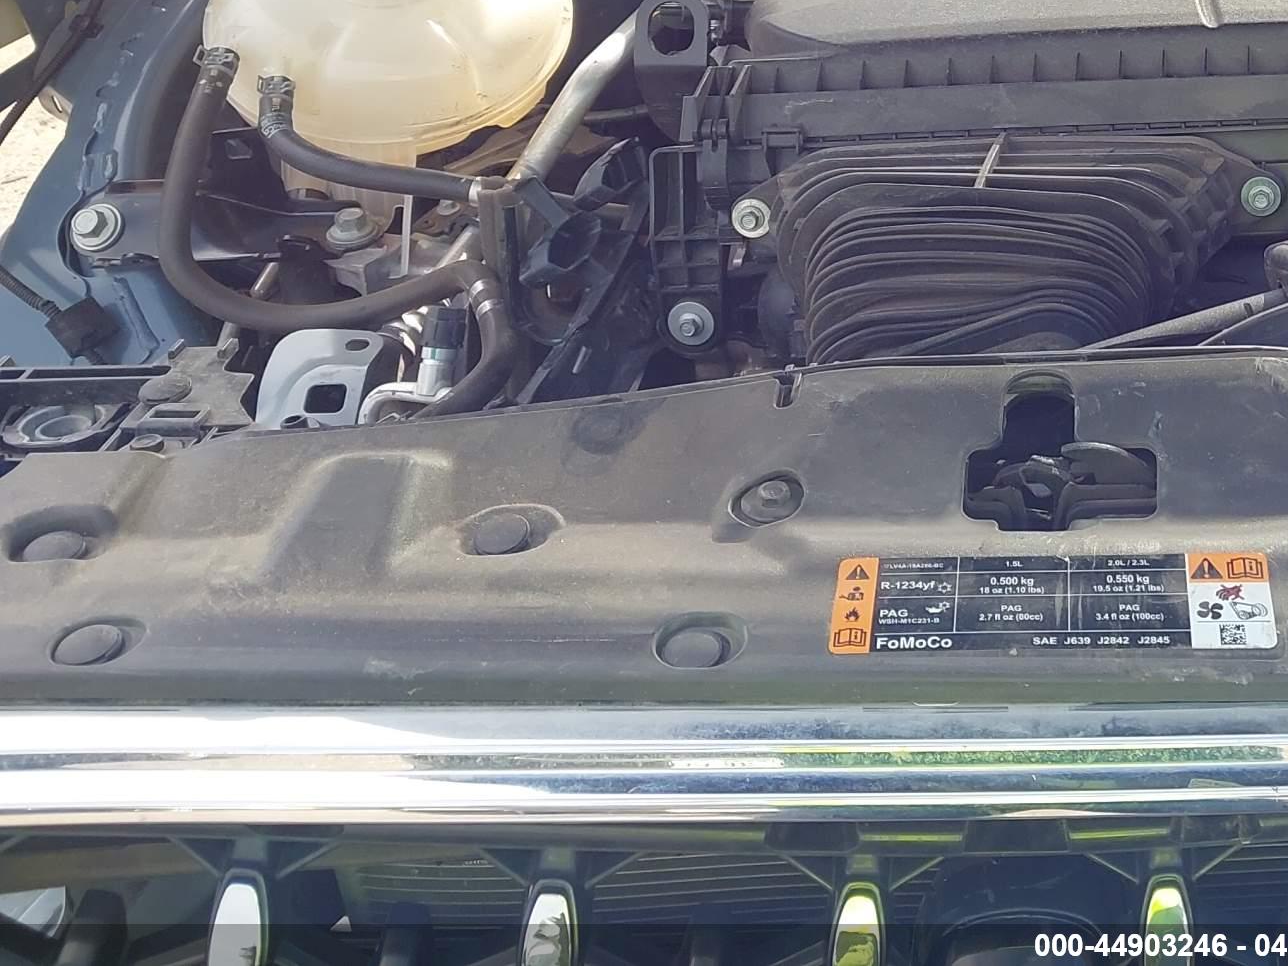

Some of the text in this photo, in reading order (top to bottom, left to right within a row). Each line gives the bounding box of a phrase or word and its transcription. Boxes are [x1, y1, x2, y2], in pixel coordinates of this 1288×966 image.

[990, 576, 1034, 587] 0.500 kg
[1106, 574, 1150, 584] 0.550 kg
[881, 580, 936, 591] R-1234yf
[1004, 586, 1026, 594] (1.10
[1027, 586, 1045, 594] lbs)
[1125, 584, 1145, 592] (1.21
[1148, 584, 1165, 592] lbs)
[879, 608, 908, 618] PAG
[978, 613, 993, 621] 2.7
[1095, 612, 1109, 621] 3.4
[1131, 612, 1164, 622] (100cc)
[876, 636, 953, 649] FoMoCo
[1032, 636, 1170, 645] SAE J639 J2842 J2845
